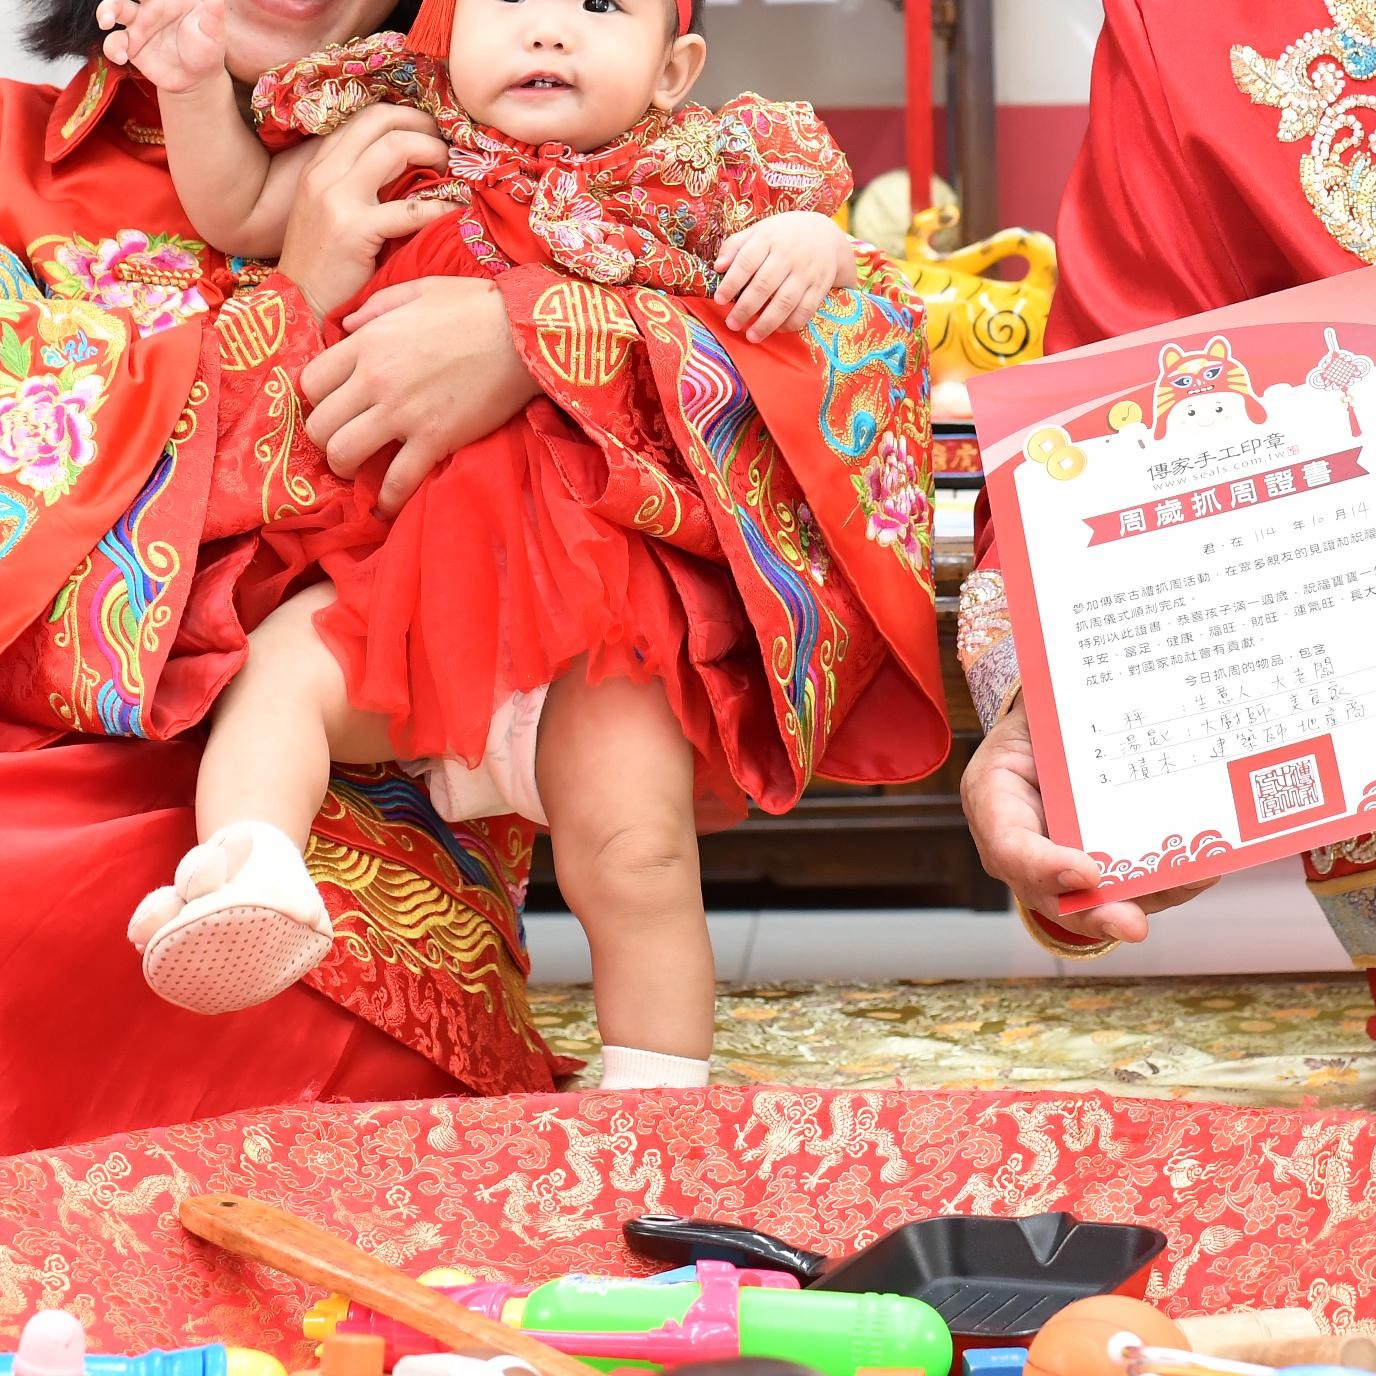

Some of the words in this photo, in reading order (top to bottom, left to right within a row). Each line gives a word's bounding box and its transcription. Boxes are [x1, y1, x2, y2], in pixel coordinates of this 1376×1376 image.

[1146, 432, 1284, 481] 傳家手工印章
[1152, 450, 1284, 490] www.seals.com.tw
[1117, 460, 1334, 537] 周歲抓周證書
